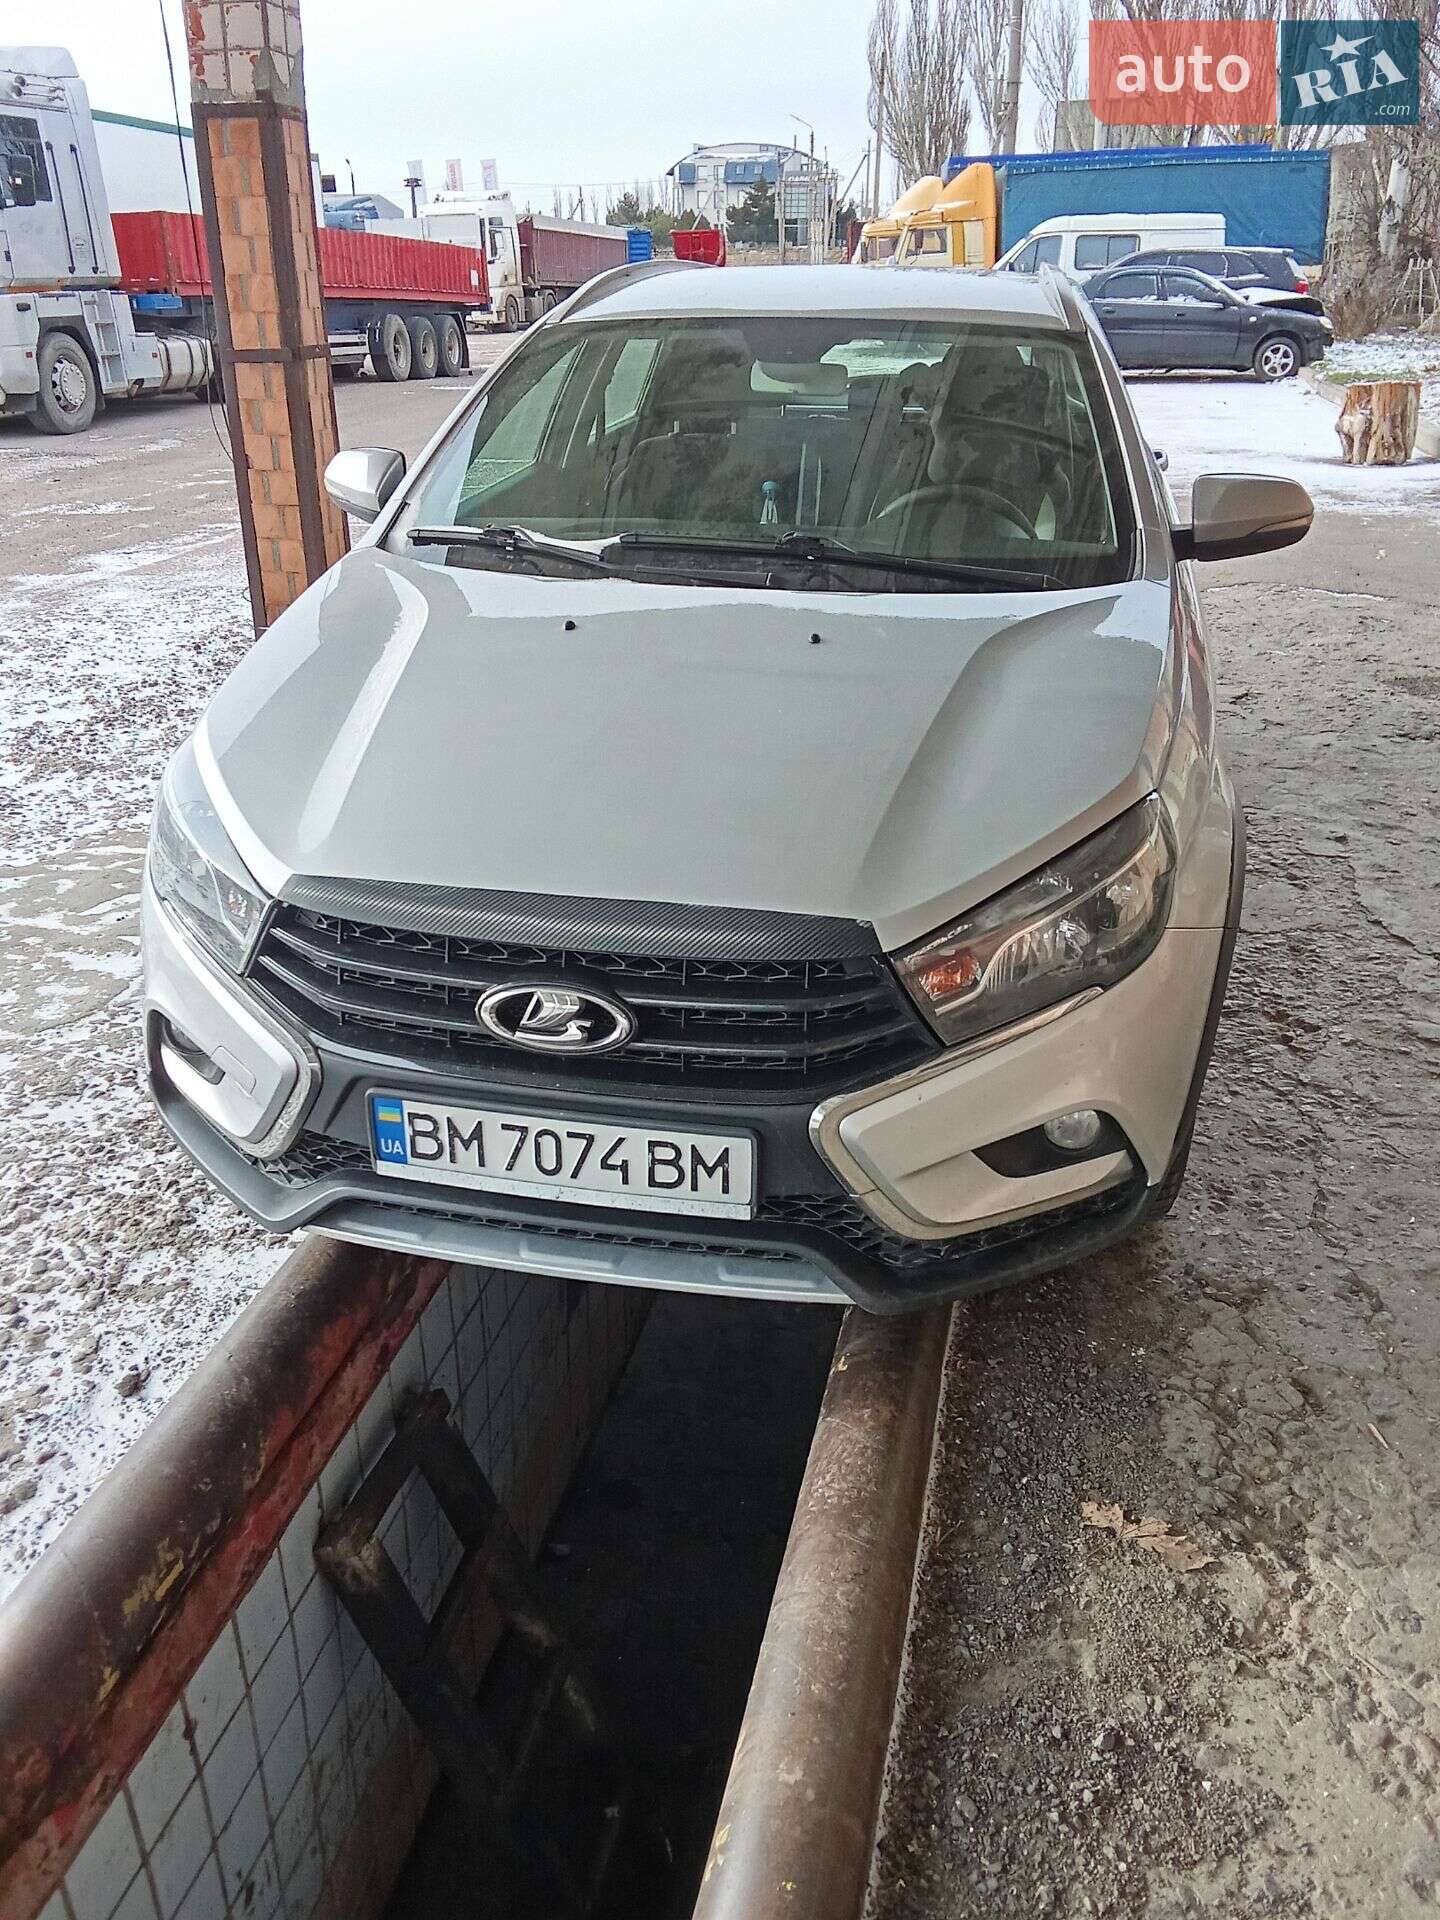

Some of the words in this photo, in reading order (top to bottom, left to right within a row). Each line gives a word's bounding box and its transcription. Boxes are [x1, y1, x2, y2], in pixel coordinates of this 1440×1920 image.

[380, 1138, 405, 1156] UA
[407, 1111, 486, 1168] BM
[501, 1123, 629, 1186] 7074
[647, 1140, 730, 1195] BM
